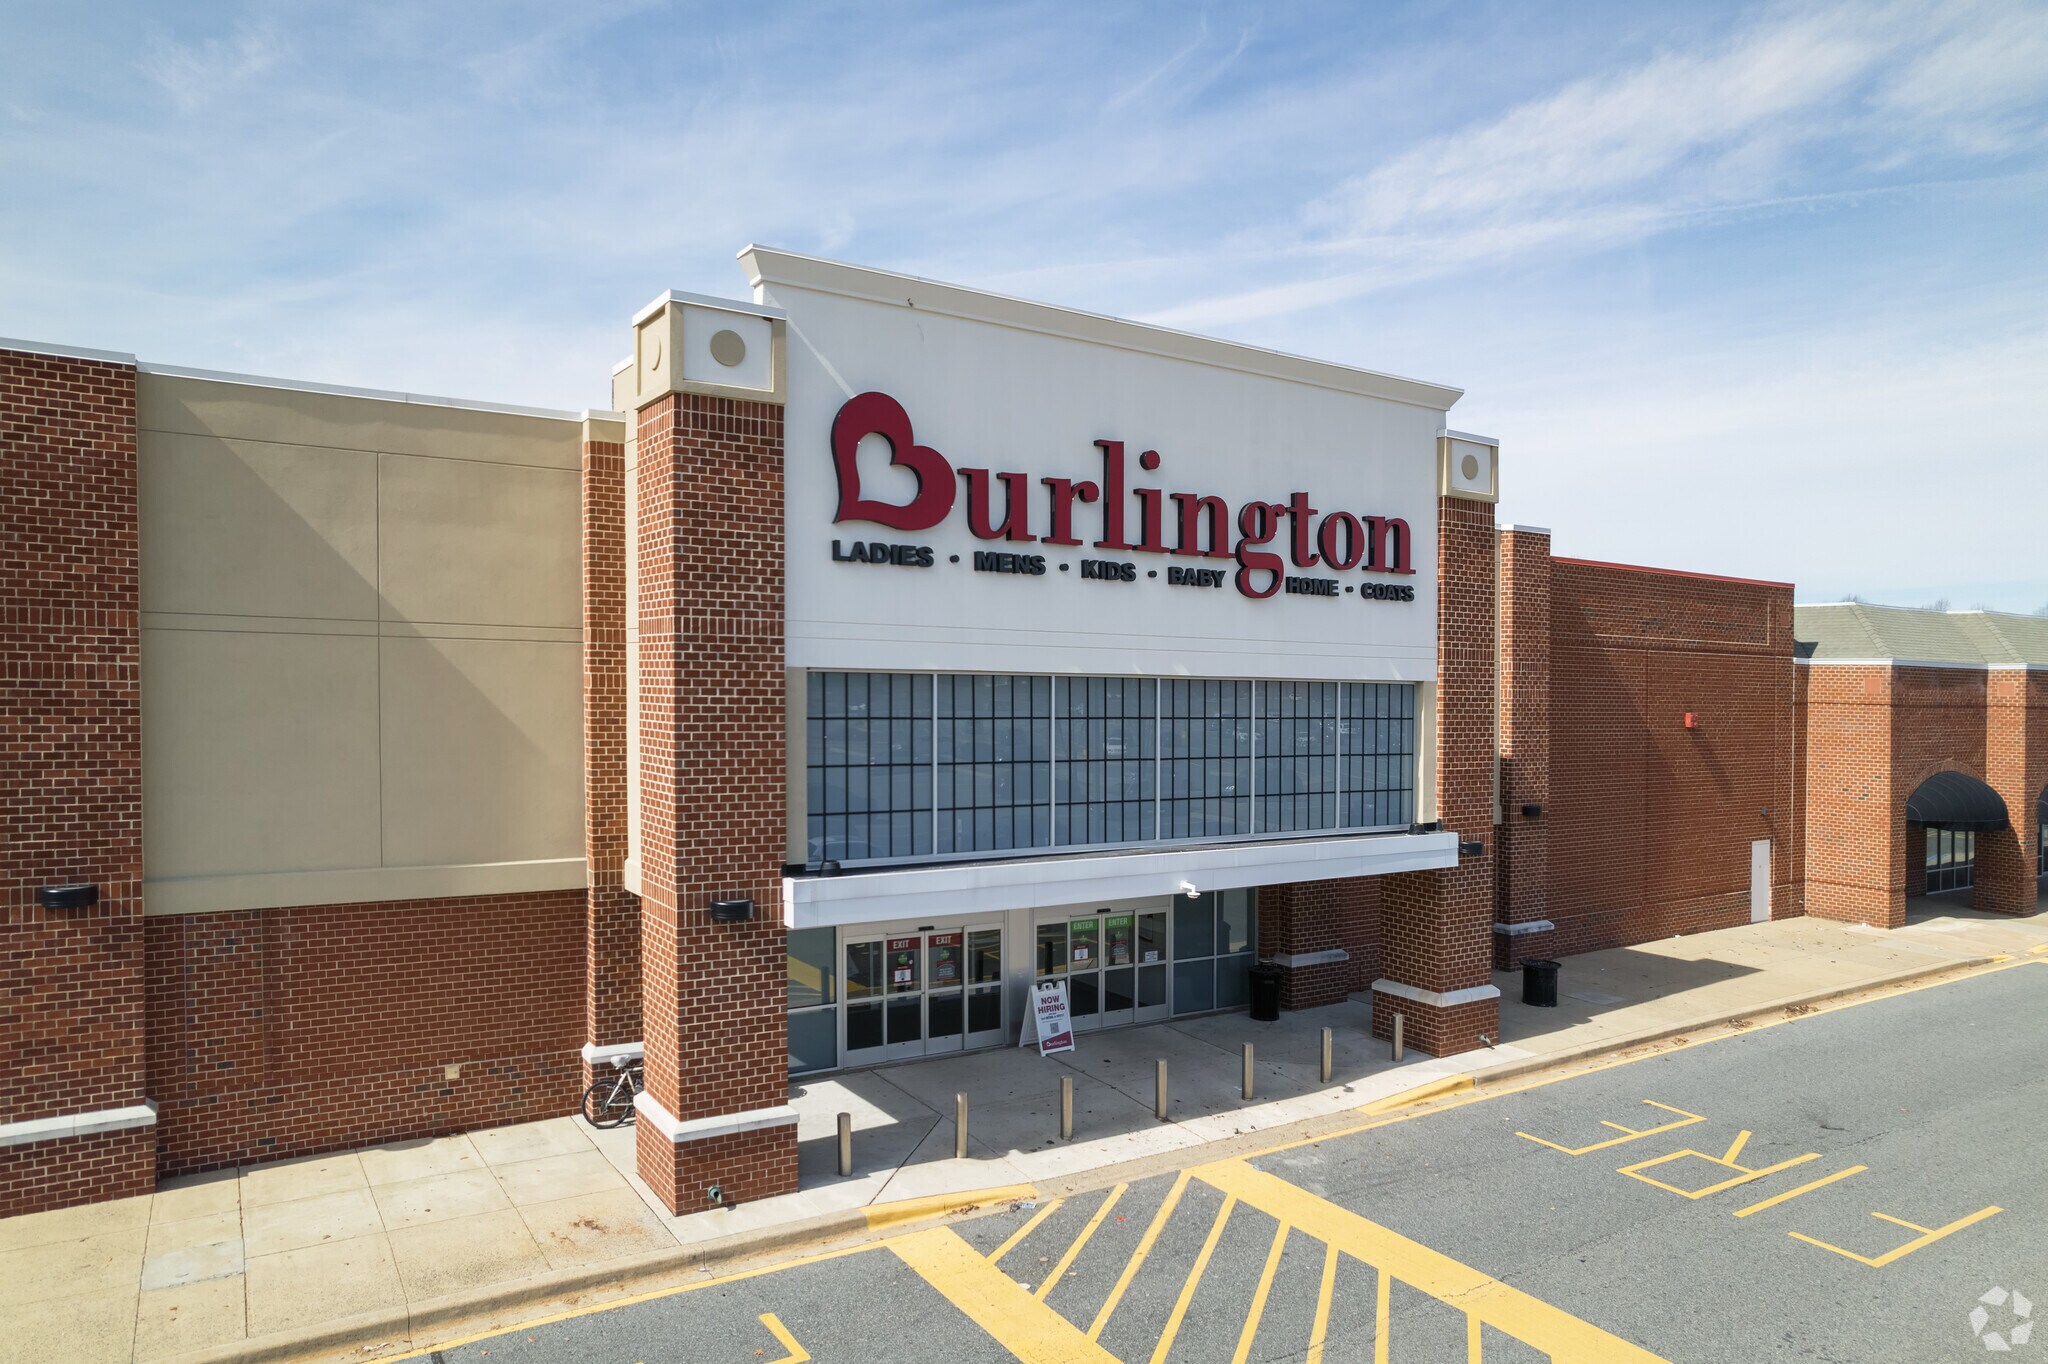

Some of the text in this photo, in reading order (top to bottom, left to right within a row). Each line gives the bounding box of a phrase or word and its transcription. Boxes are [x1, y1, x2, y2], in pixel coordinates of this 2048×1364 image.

[830, 391, 1417, 599] Burlington
[832, 540, 1415, 602] LADIES MENS KIDS BABY HOME COATS
[1073, 920, 1094, 930] ENTER
[1108, 917, 1128, 927] ENTER
[893, 940, 910, 949] EXIT
[936, 936, 952, 945] EXIT
[1040, 995, 1060, 1005] NOW
[1037, 1003, 1066, 1015] HIRING
